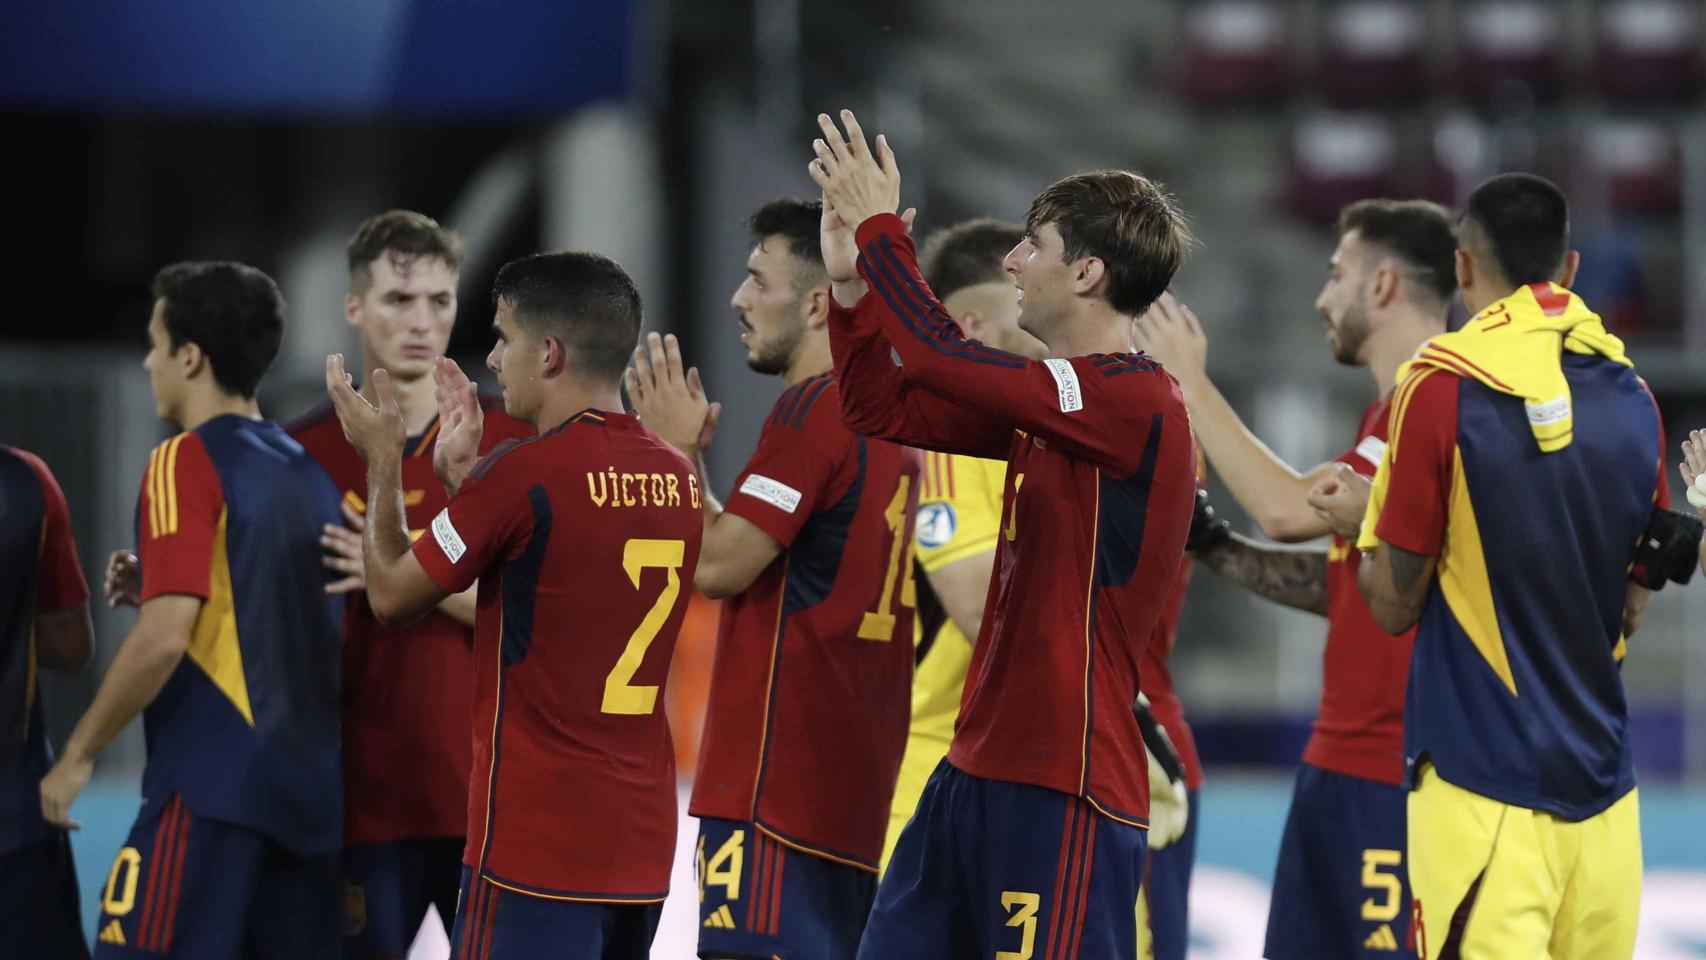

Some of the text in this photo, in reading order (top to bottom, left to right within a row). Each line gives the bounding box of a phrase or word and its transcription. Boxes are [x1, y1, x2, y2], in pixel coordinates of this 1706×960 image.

[587, 466, 680, 507] VÍCTOR
[601, 538, 685, 715] 2
[98, 846, 141, 915] 0
[1360, 849, 1401, 921] 5
[995, 890, 1040, 960] 3
